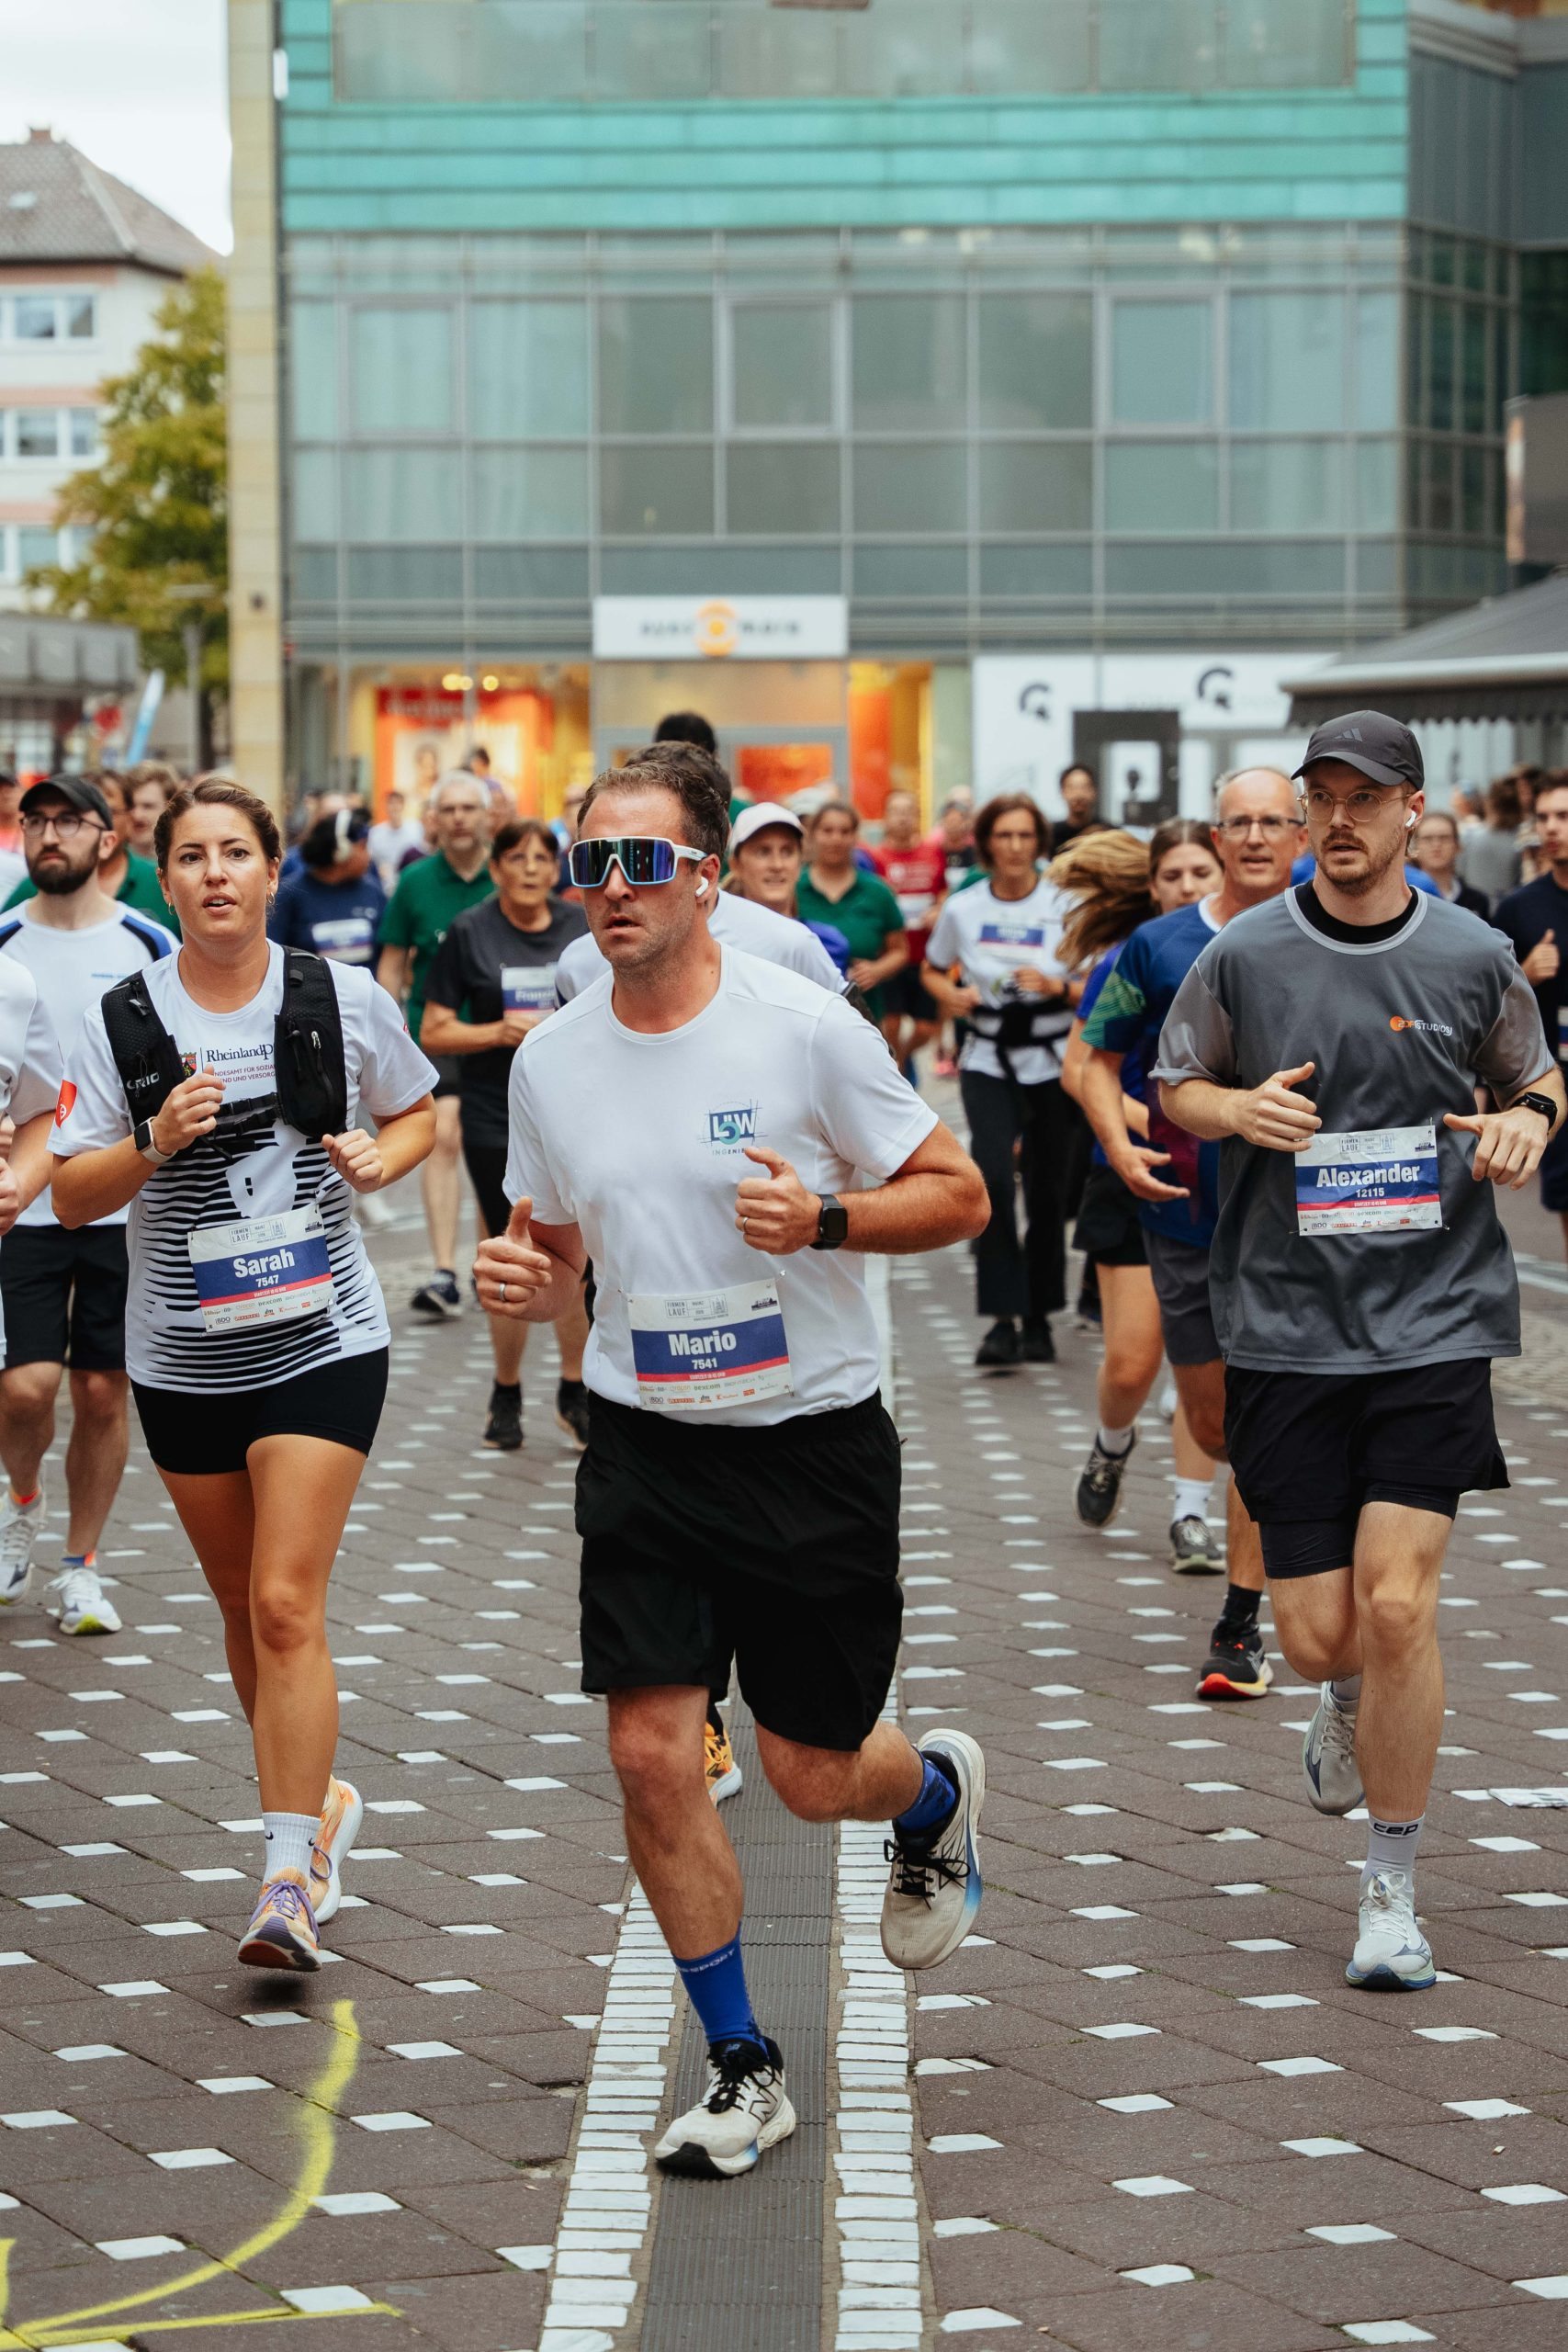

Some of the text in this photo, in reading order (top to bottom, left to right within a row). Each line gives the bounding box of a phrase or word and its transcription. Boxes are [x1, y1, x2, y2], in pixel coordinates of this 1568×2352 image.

[206, 1043, 275, 1062] RheinlandP
[214, 1068, 243, 1077] NDESAMT
[256, 1064, 276, 1072] SOZIA
[248, 1071, 276, 1080] VERSORG
[712, 1148, 746, 1156] INGENIE
[1341, 1144, 1359, 1152] LAUF
[1316, 1163, 1421, 1188] Alexander
[1356, 1187, 1385, 1198] 12115
[232, 1233, 250, 1243] LAUF
[232, 1248, 296, 1278] Sarah
[255, 1274, 279, 1288] 7547
[668, 1307, 686, 1317] LAUF
[668, 1330, 737, 1356] Mario
[691, 1357, 717, 1370] 7541
[1373, 1823, 1419, 1836] cep
